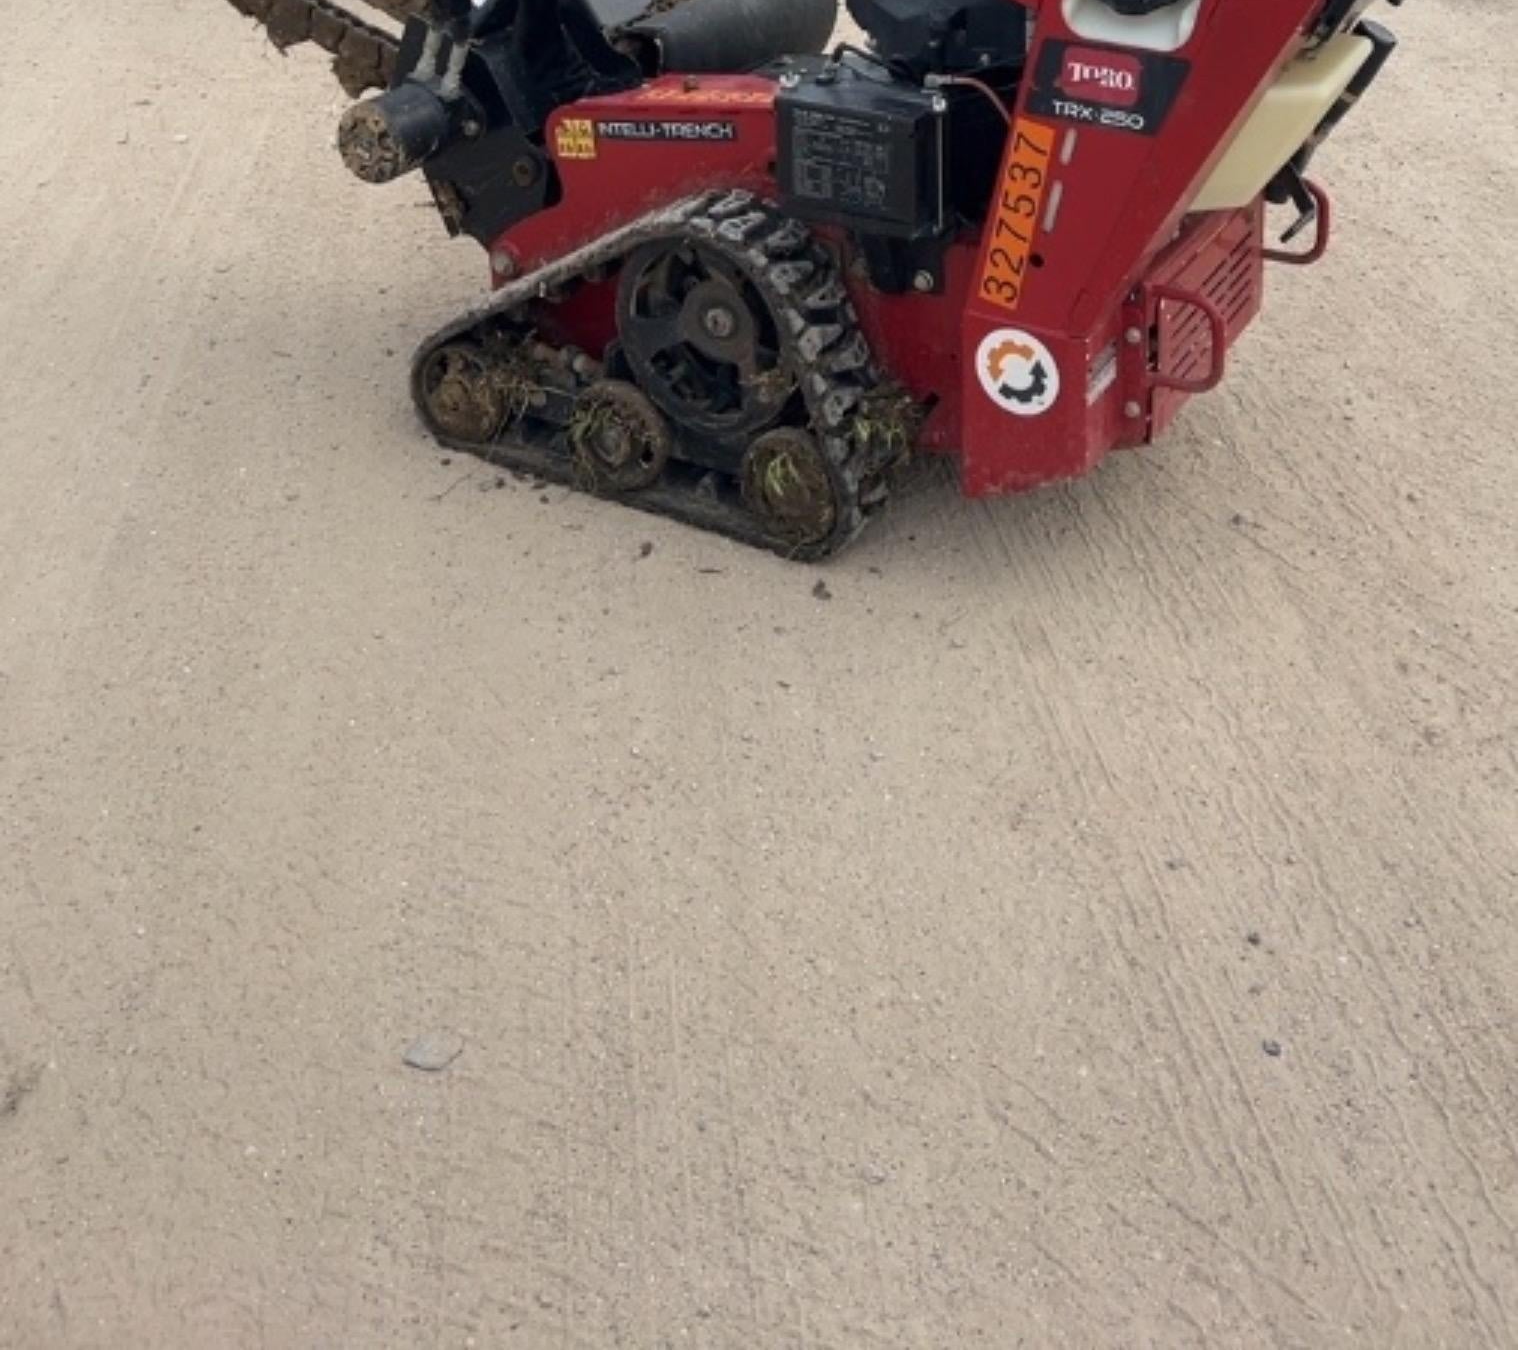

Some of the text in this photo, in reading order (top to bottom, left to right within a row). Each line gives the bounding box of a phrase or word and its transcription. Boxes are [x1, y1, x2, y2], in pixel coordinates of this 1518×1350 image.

[1067, 62, 1136, 90] TORO
[598, 122, 734, 139] INTELLI-TRENCH
[983, 130, 1048, 302] 327537
